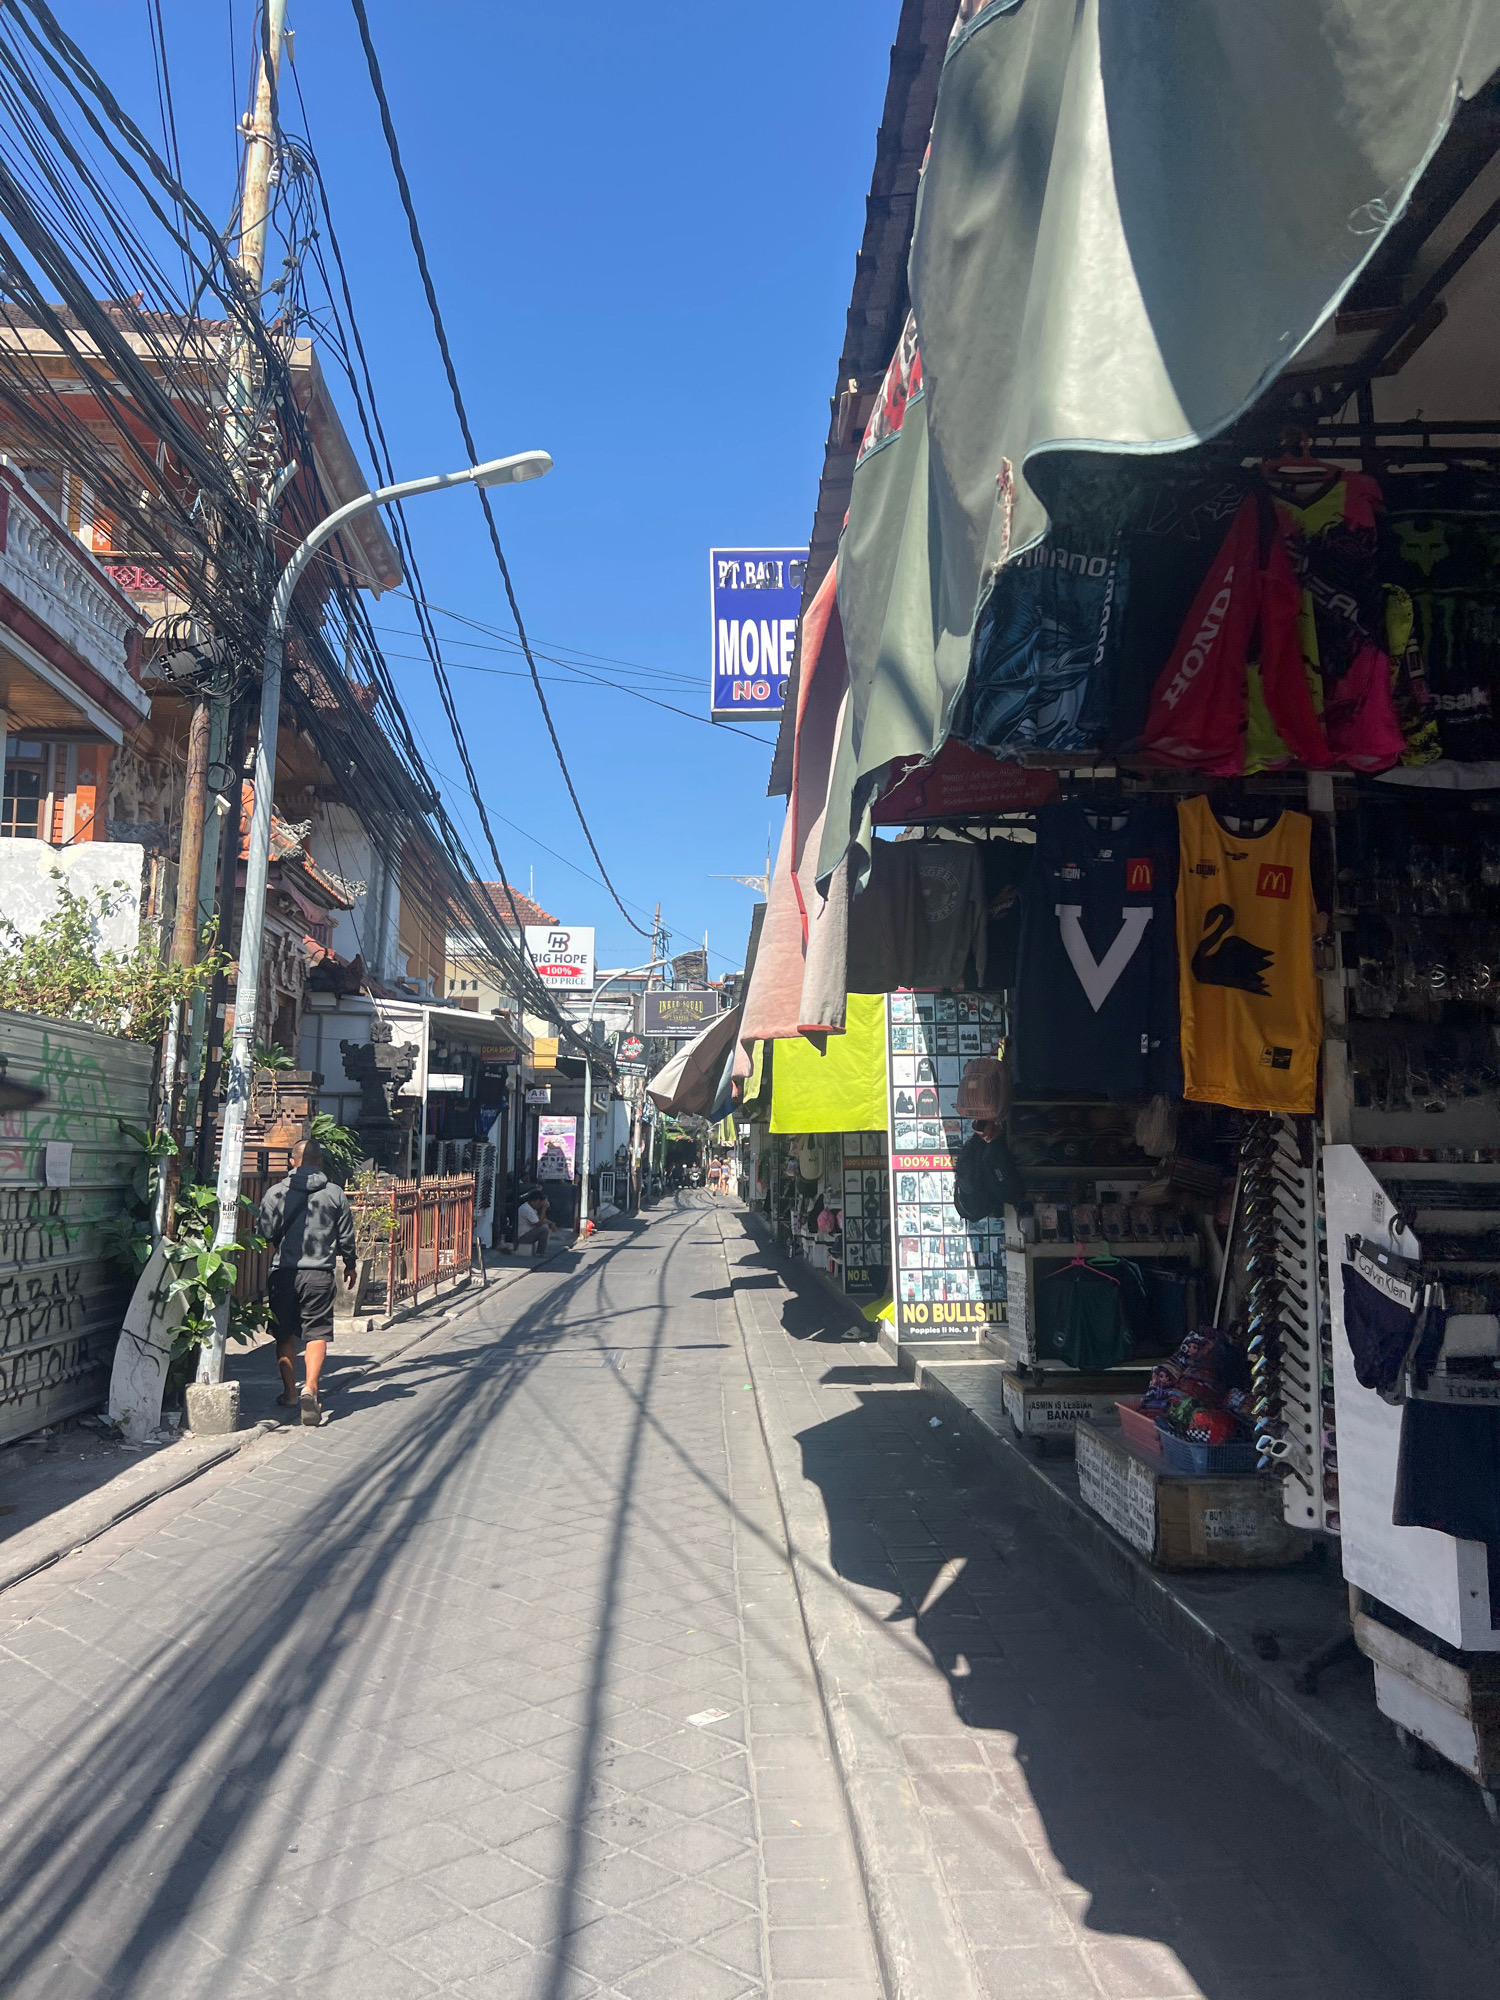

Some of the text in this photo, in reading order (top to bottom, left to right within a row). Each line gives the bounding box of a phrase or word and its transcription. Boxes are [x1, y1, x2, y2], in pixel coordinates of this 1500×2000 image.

[718, 619, 799, 676] MONE
[732, 680, 771, 701] NO
[531, 953, 588, 964] BIG HOPE
[1055, 903, 1153, 1013] V
[546, 967, 572, 975] 100%
[899, 1156, 958, 1167] 100% FIXE
[847, 1270, 860, 1281] NO
[903, 1303, 929, 1323] NO
[910, 1327, 941, 1335] Poppies
